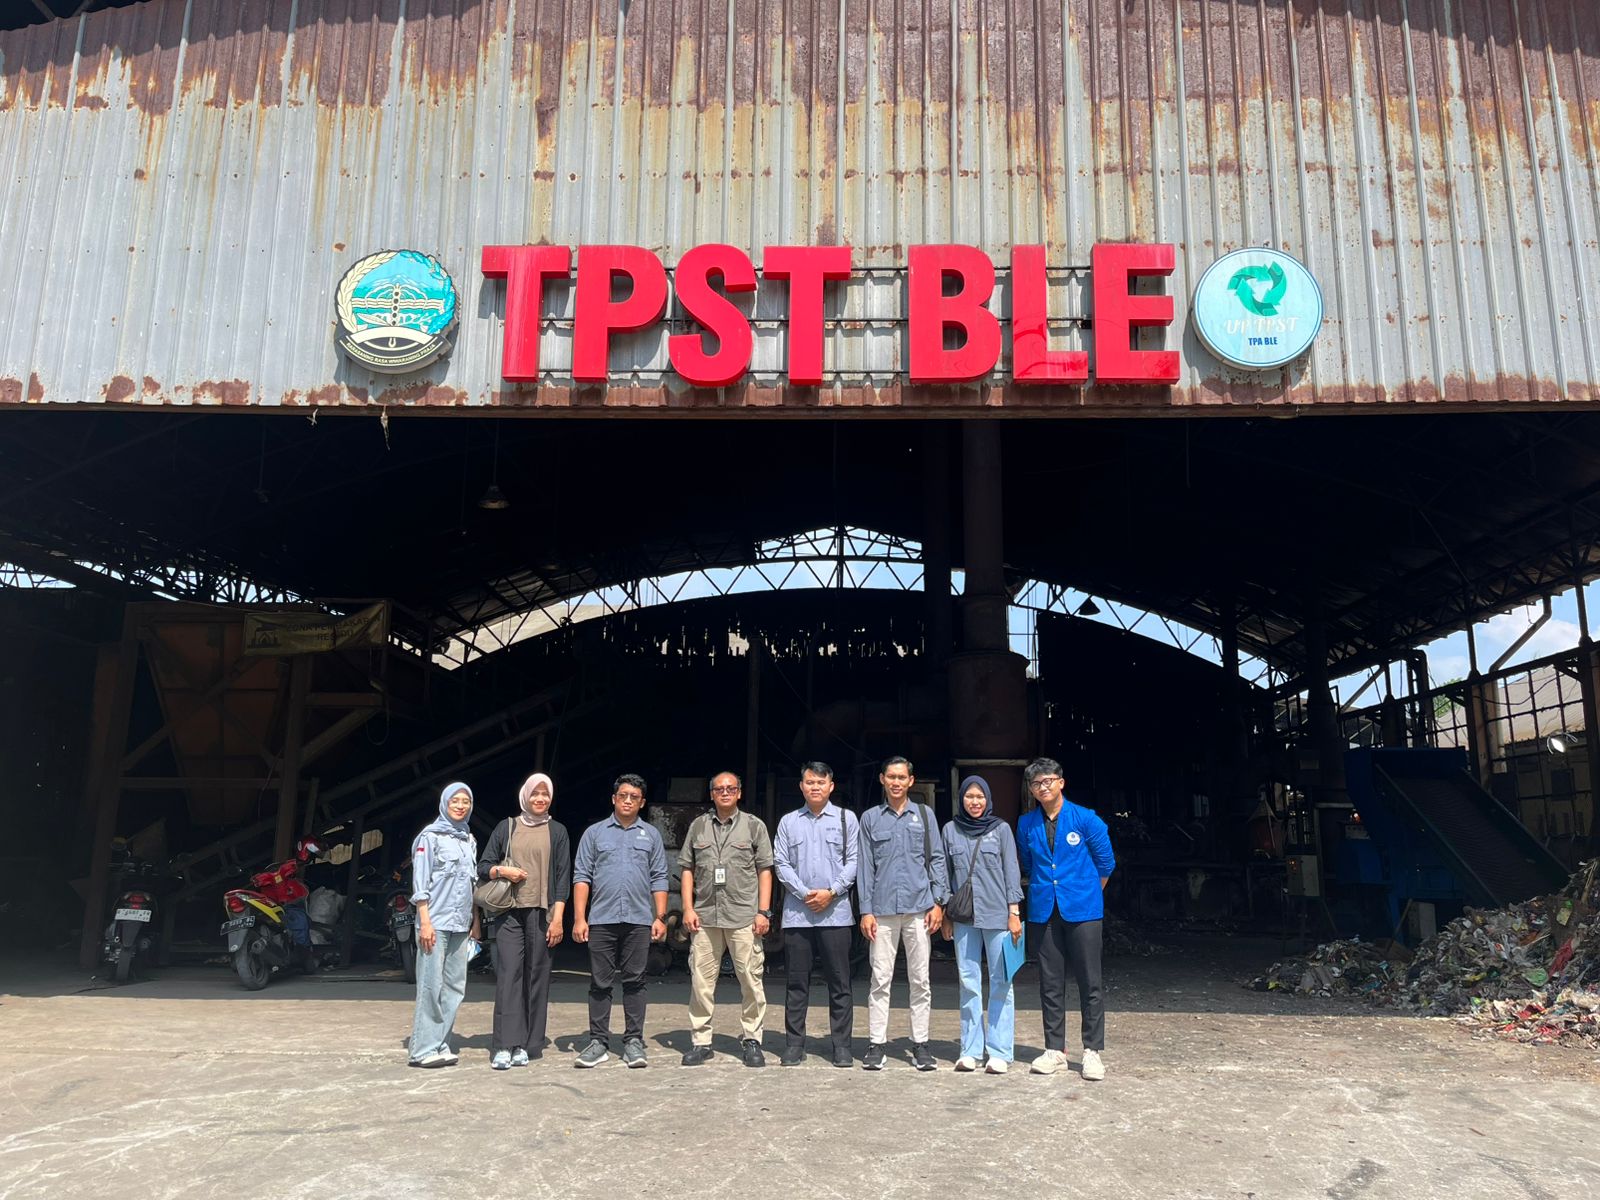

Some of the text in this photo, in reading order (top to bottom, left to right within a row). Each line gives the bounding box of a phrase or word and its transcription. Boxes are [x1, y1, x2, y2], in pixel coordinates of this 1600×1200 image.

[481, 243, 1180, 387] TPST BLE
[1248, 336, 1278, 346] TPA BLE
